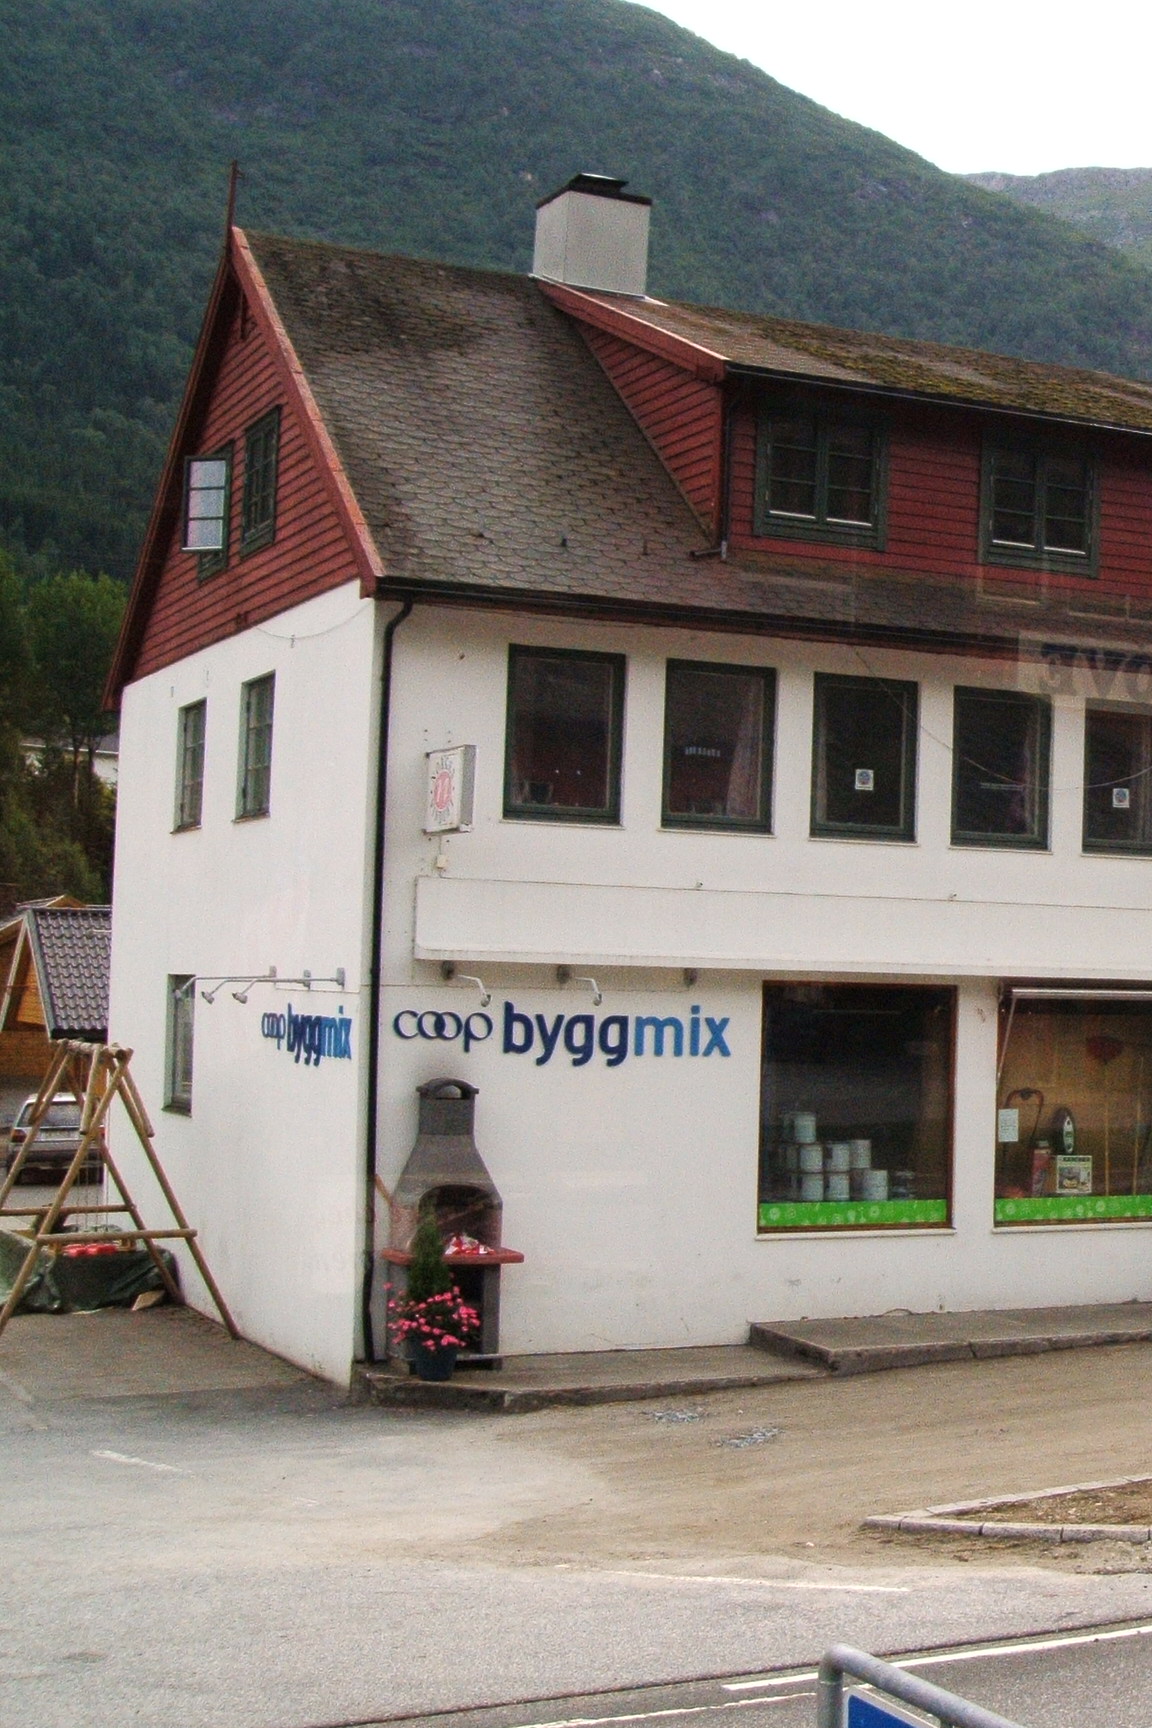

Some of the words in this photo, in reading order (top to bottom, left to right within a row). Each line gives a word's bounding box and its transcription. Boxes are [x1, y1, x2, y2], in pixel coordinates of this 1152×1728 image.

[262, 1013, 286, 1050] coop
[287, 1003, 352, 1067] byggmix
[393, 1010, 493, 1052] coop
[502, 1001, 732, 1067] byggmix
